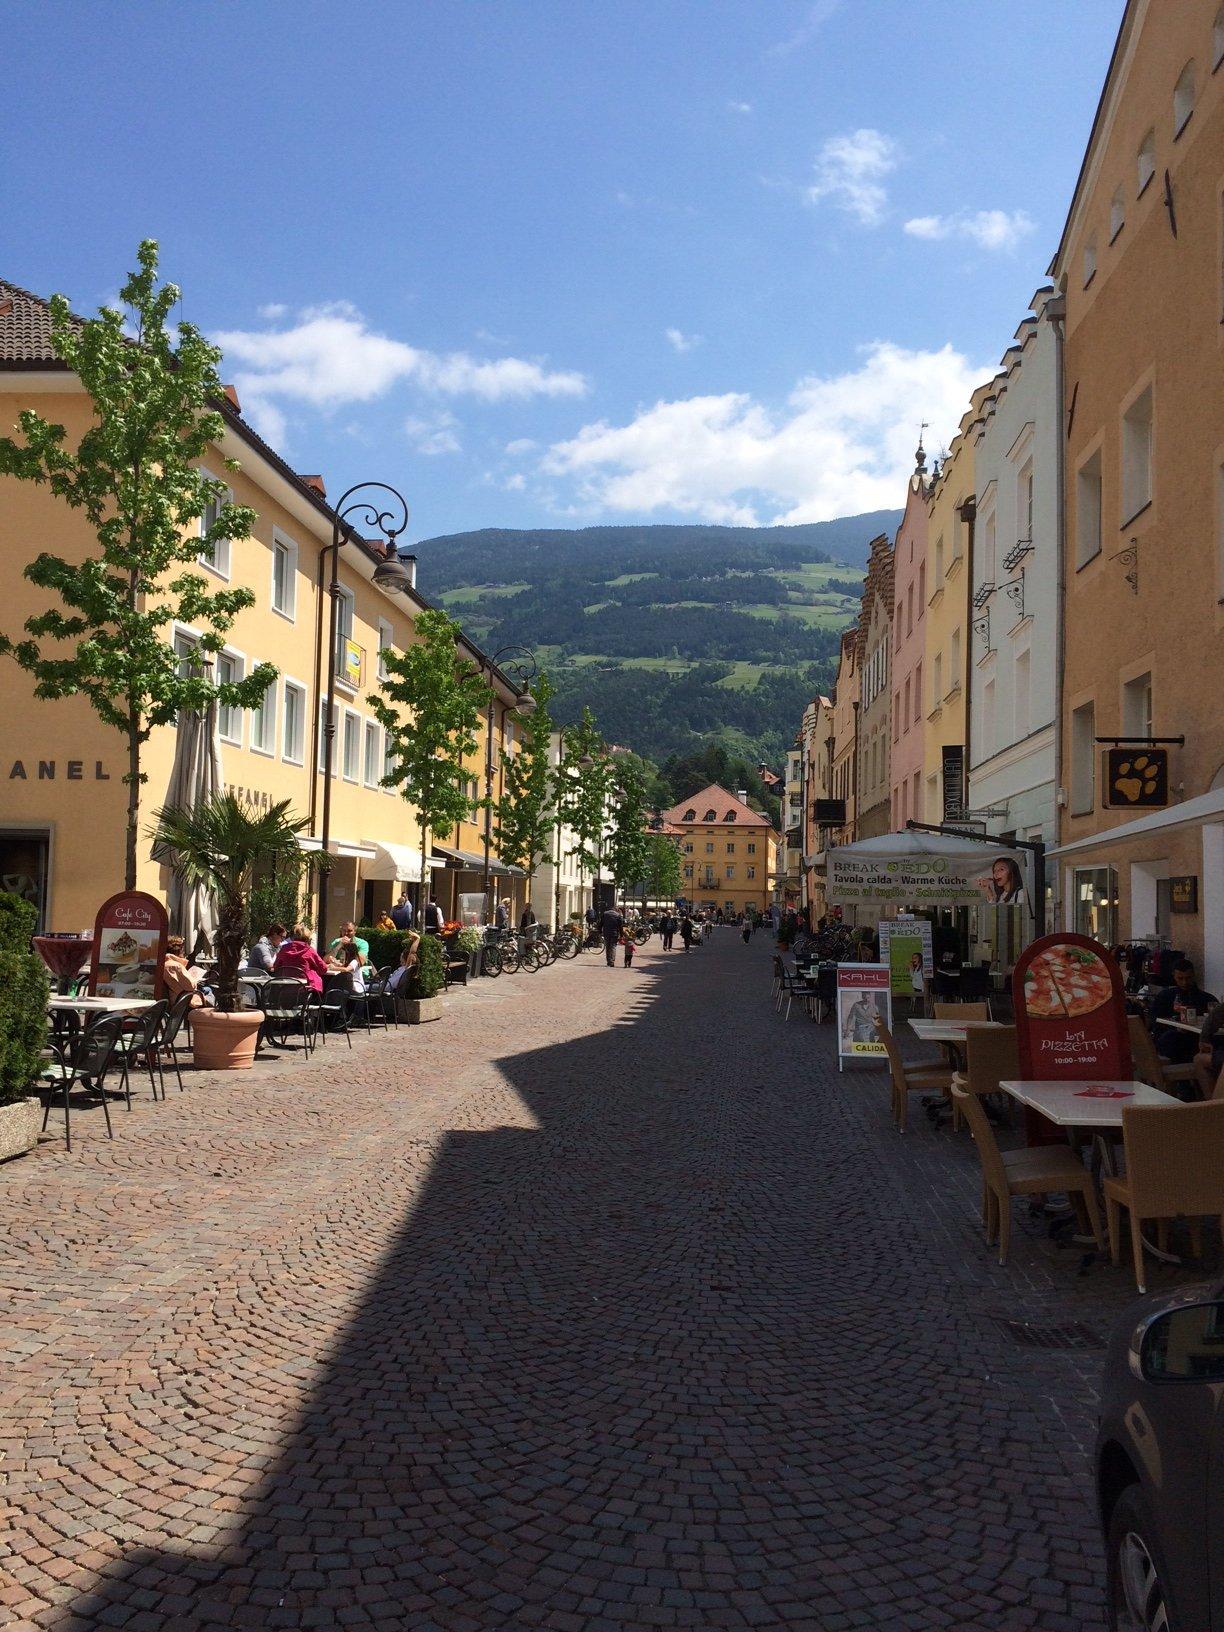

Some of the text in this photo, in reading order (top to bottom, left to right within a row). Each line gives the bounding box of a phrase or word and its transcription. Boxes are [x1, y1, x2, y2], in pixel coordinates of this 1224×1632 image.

[833, 862, 879, 873] BREAK
[834, 874, 864, 884] Tavola
[867, 875, 892, 884] calda
[901, 875, 935, 885] Warme
[938, 874, 967, 885] Küche
[832, 885, 860, 896] Pizza
[839, 973, 888, 982] KAHL
[1065, 1030, 1085, 1041] LA
[855, 1044, 886, 1052] CALIDA
[1040, 1037, 1109, 1052] PIZZETTA
